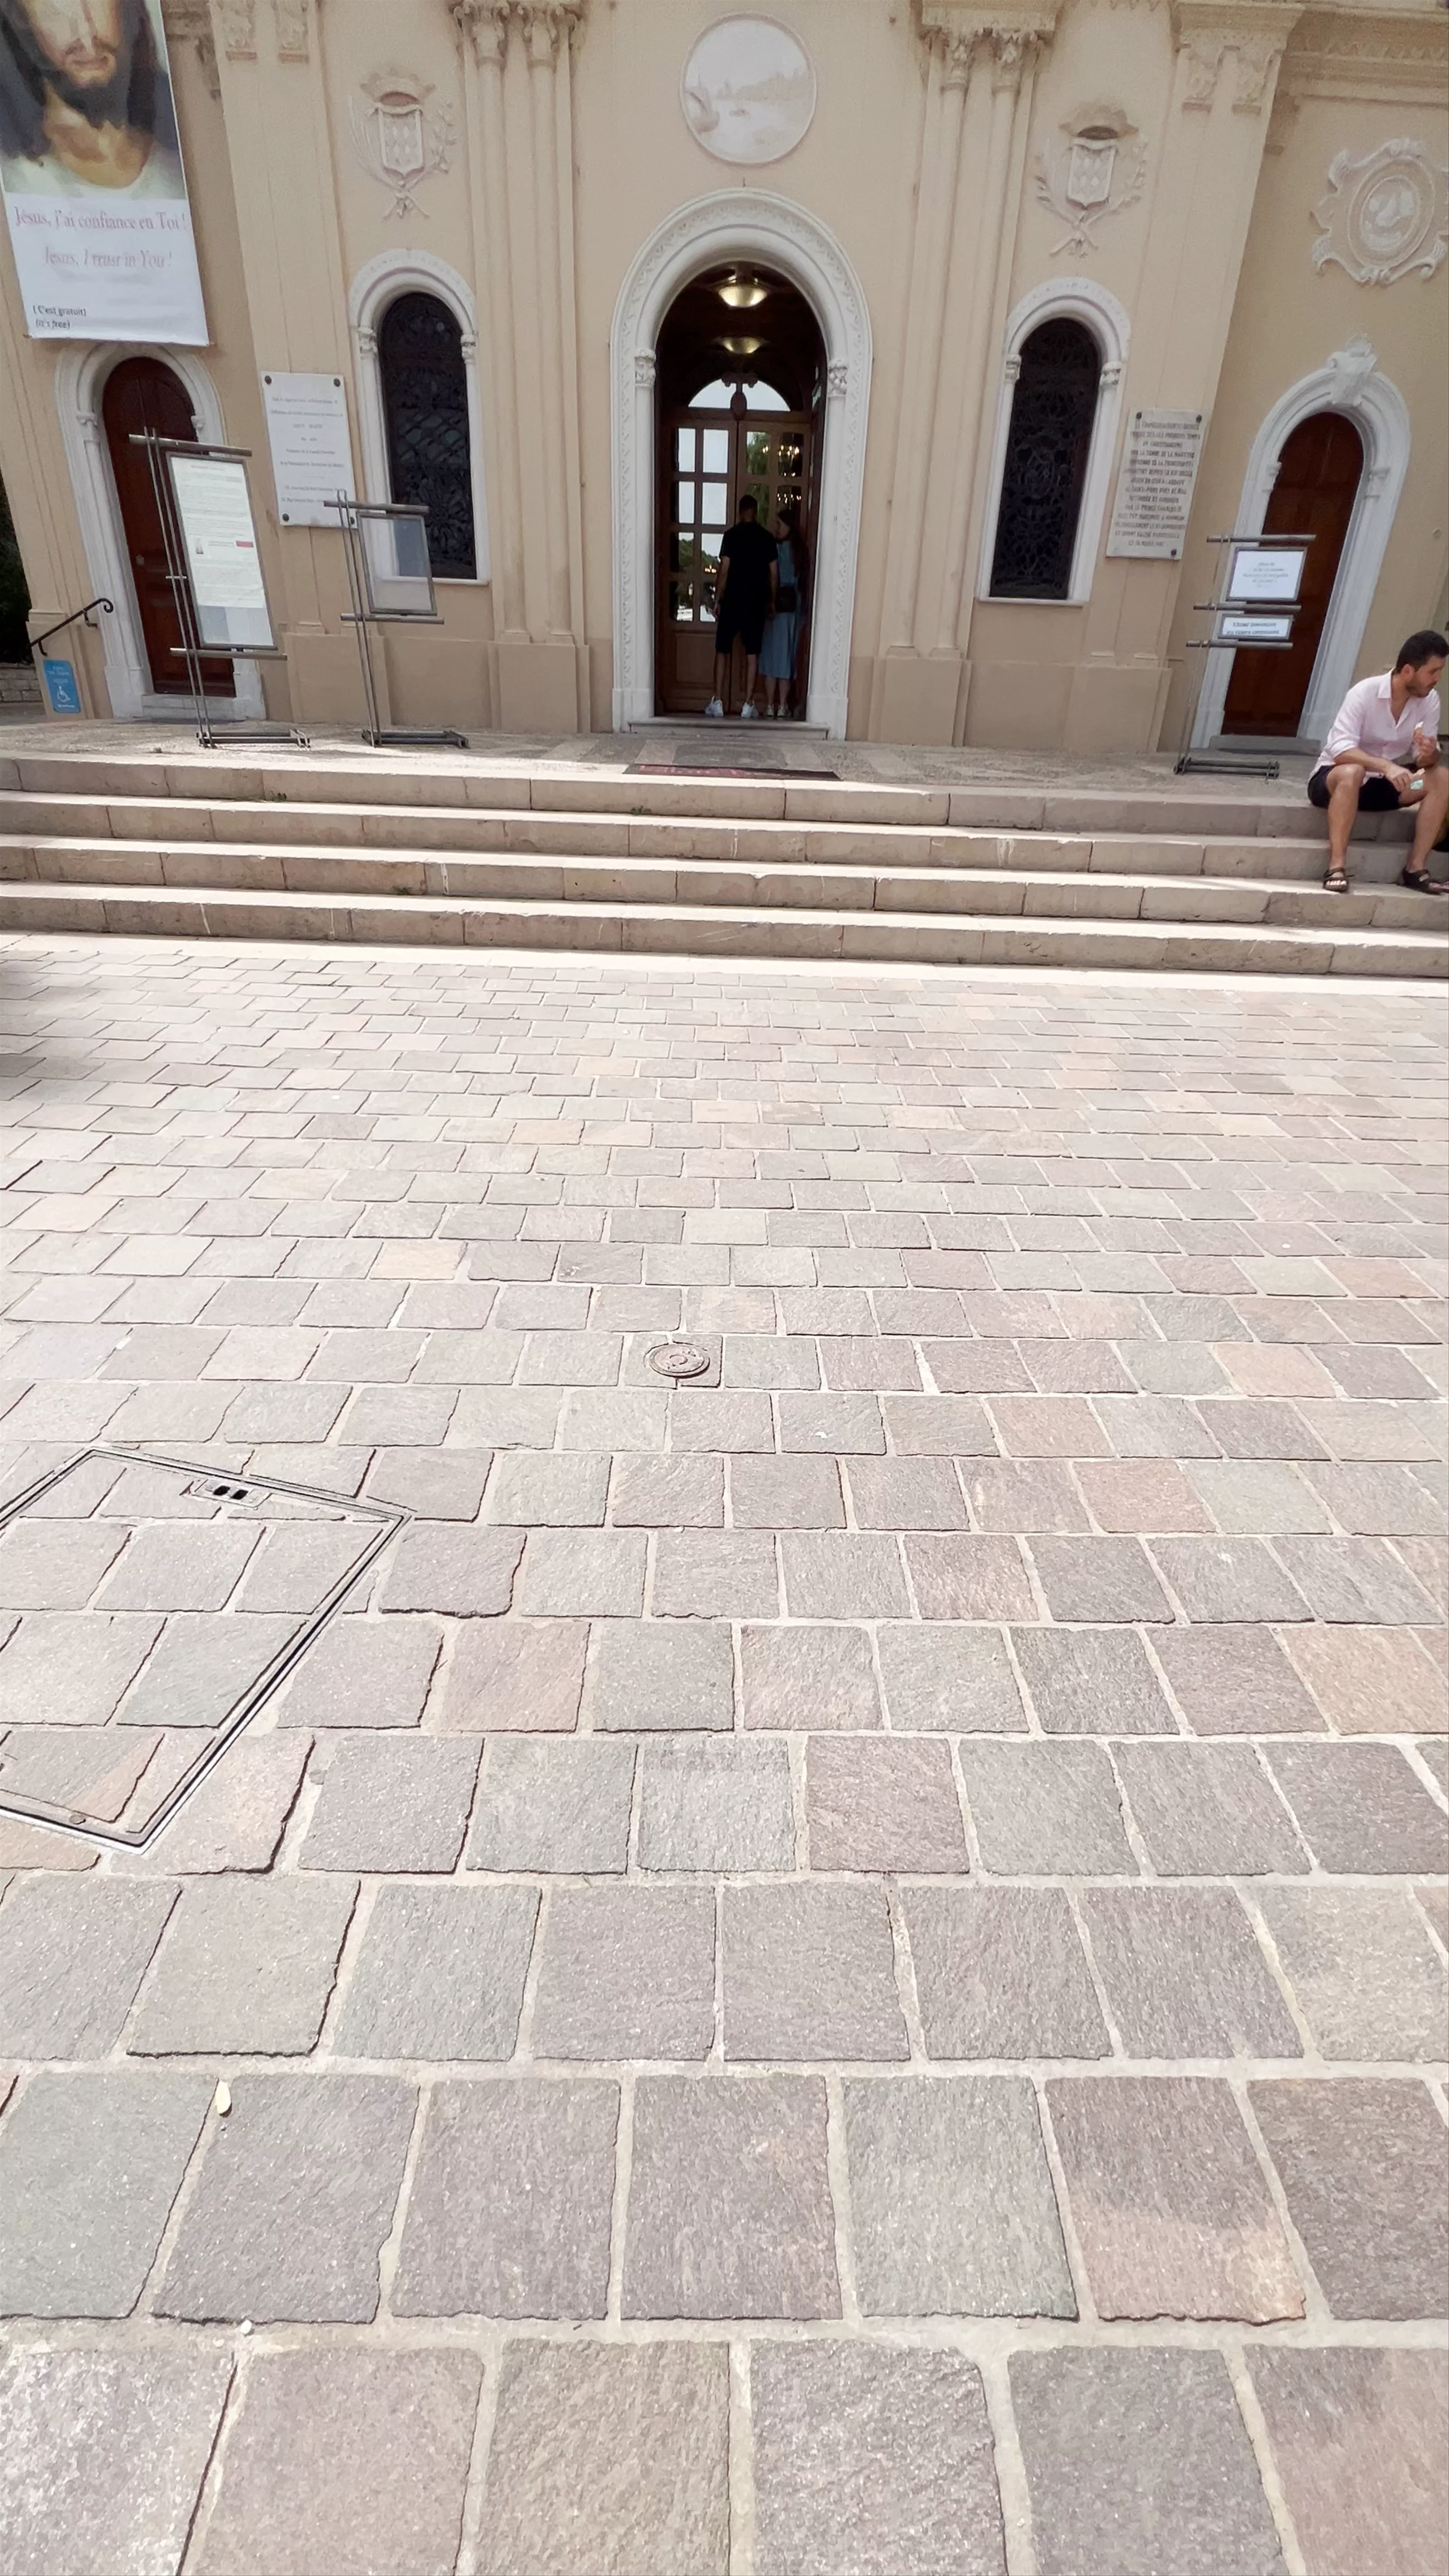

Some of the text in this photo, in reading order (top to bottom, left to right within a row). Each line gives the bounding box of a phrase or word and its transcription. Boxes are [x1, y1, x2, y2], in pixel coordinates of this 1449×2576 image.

[78, 211, 136, 229] confiance
[138, 217, 154, 230] en
[155, 211, 180, 231] Toi
[92, 253, 121, 267] trust
[124, 252, 136, 268] in
[139, 249, 165, 269] You
